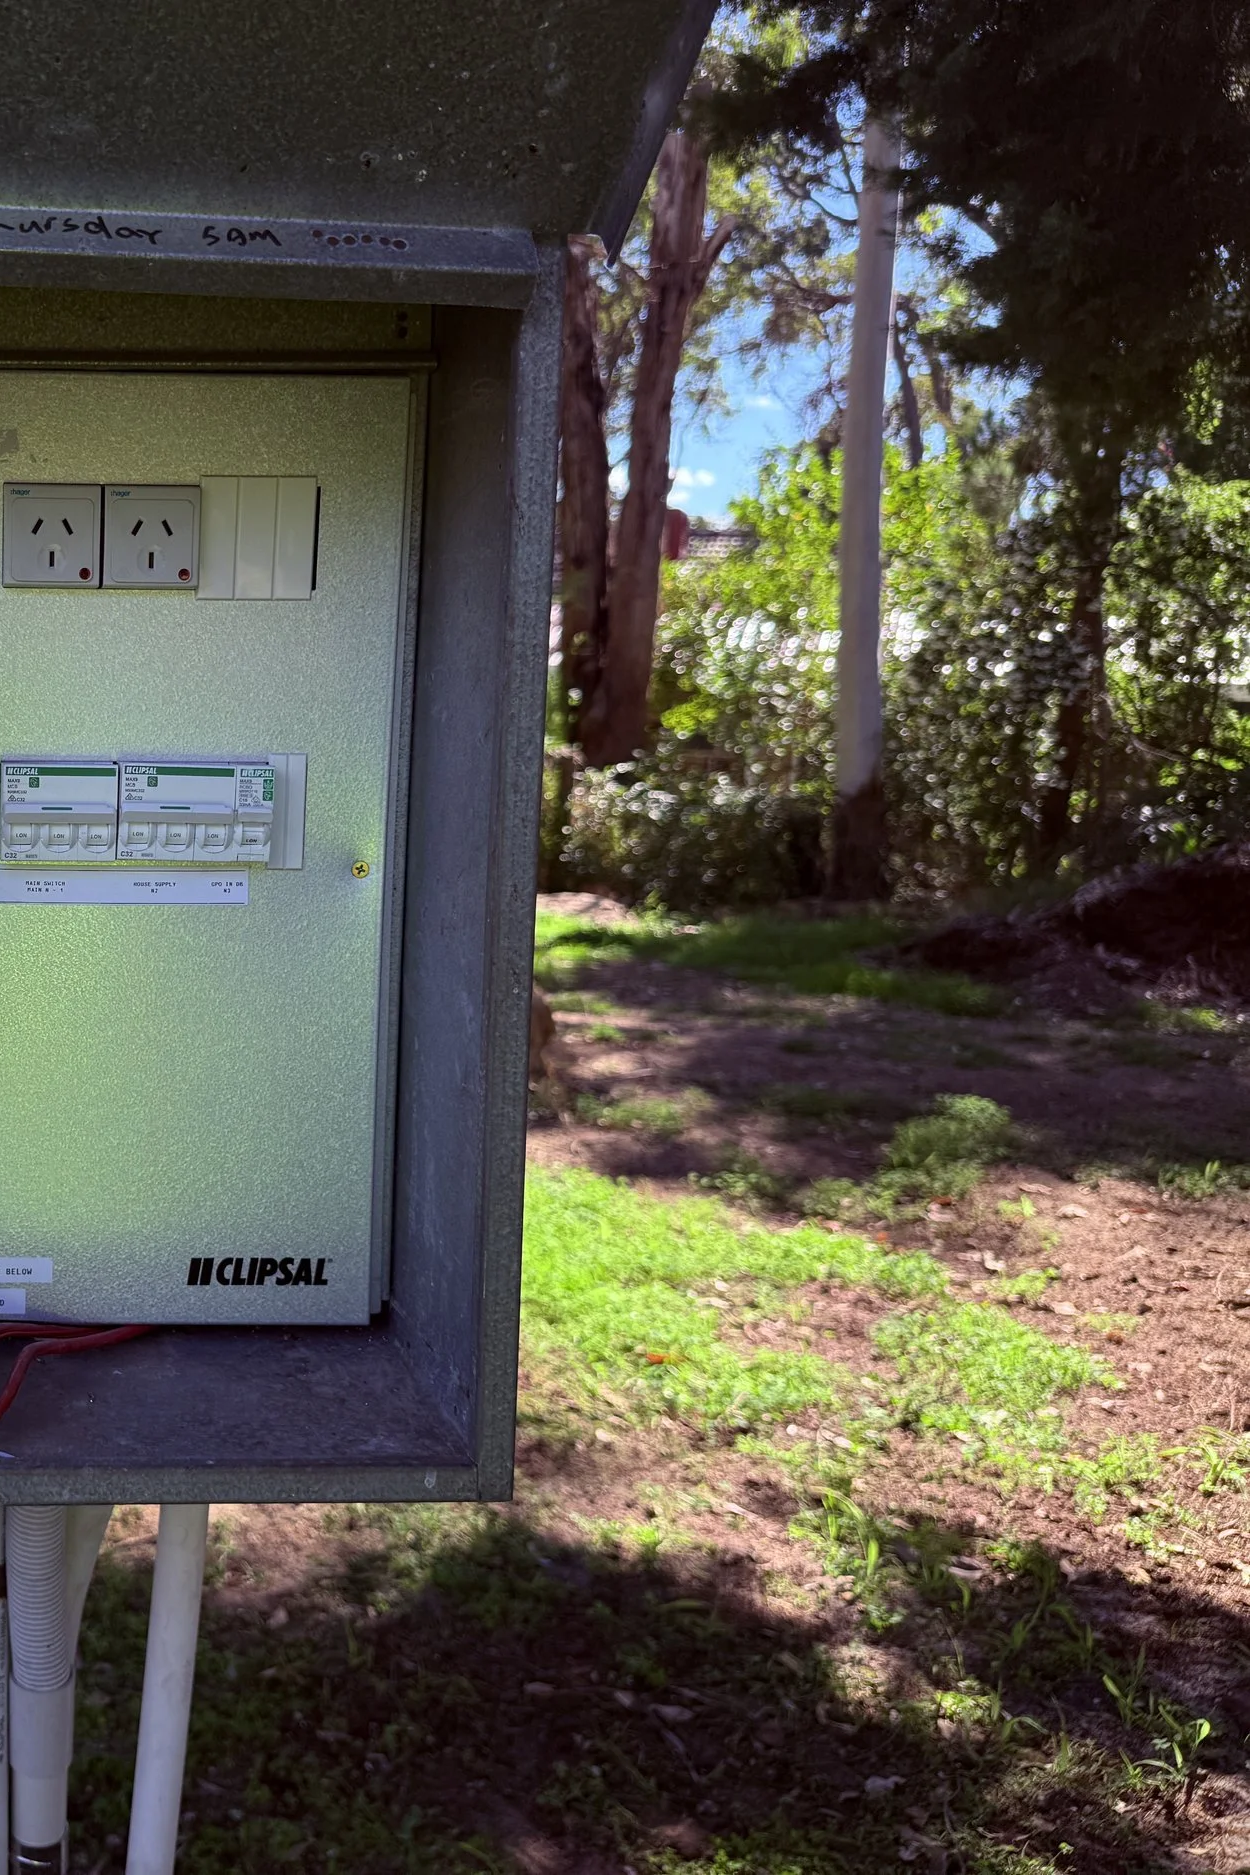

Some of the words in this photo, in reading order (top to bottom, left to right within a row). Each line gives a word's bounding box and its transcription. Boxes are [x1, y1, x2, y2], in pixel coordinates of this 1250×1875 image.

[13, 767, 38, 775] CLIPSAL
[132, 766, 157, 775] CLIPSAL
[4, 1267, 33, 1276] BELOW
[216, 1256, 328, 1286] CLIPSAL
